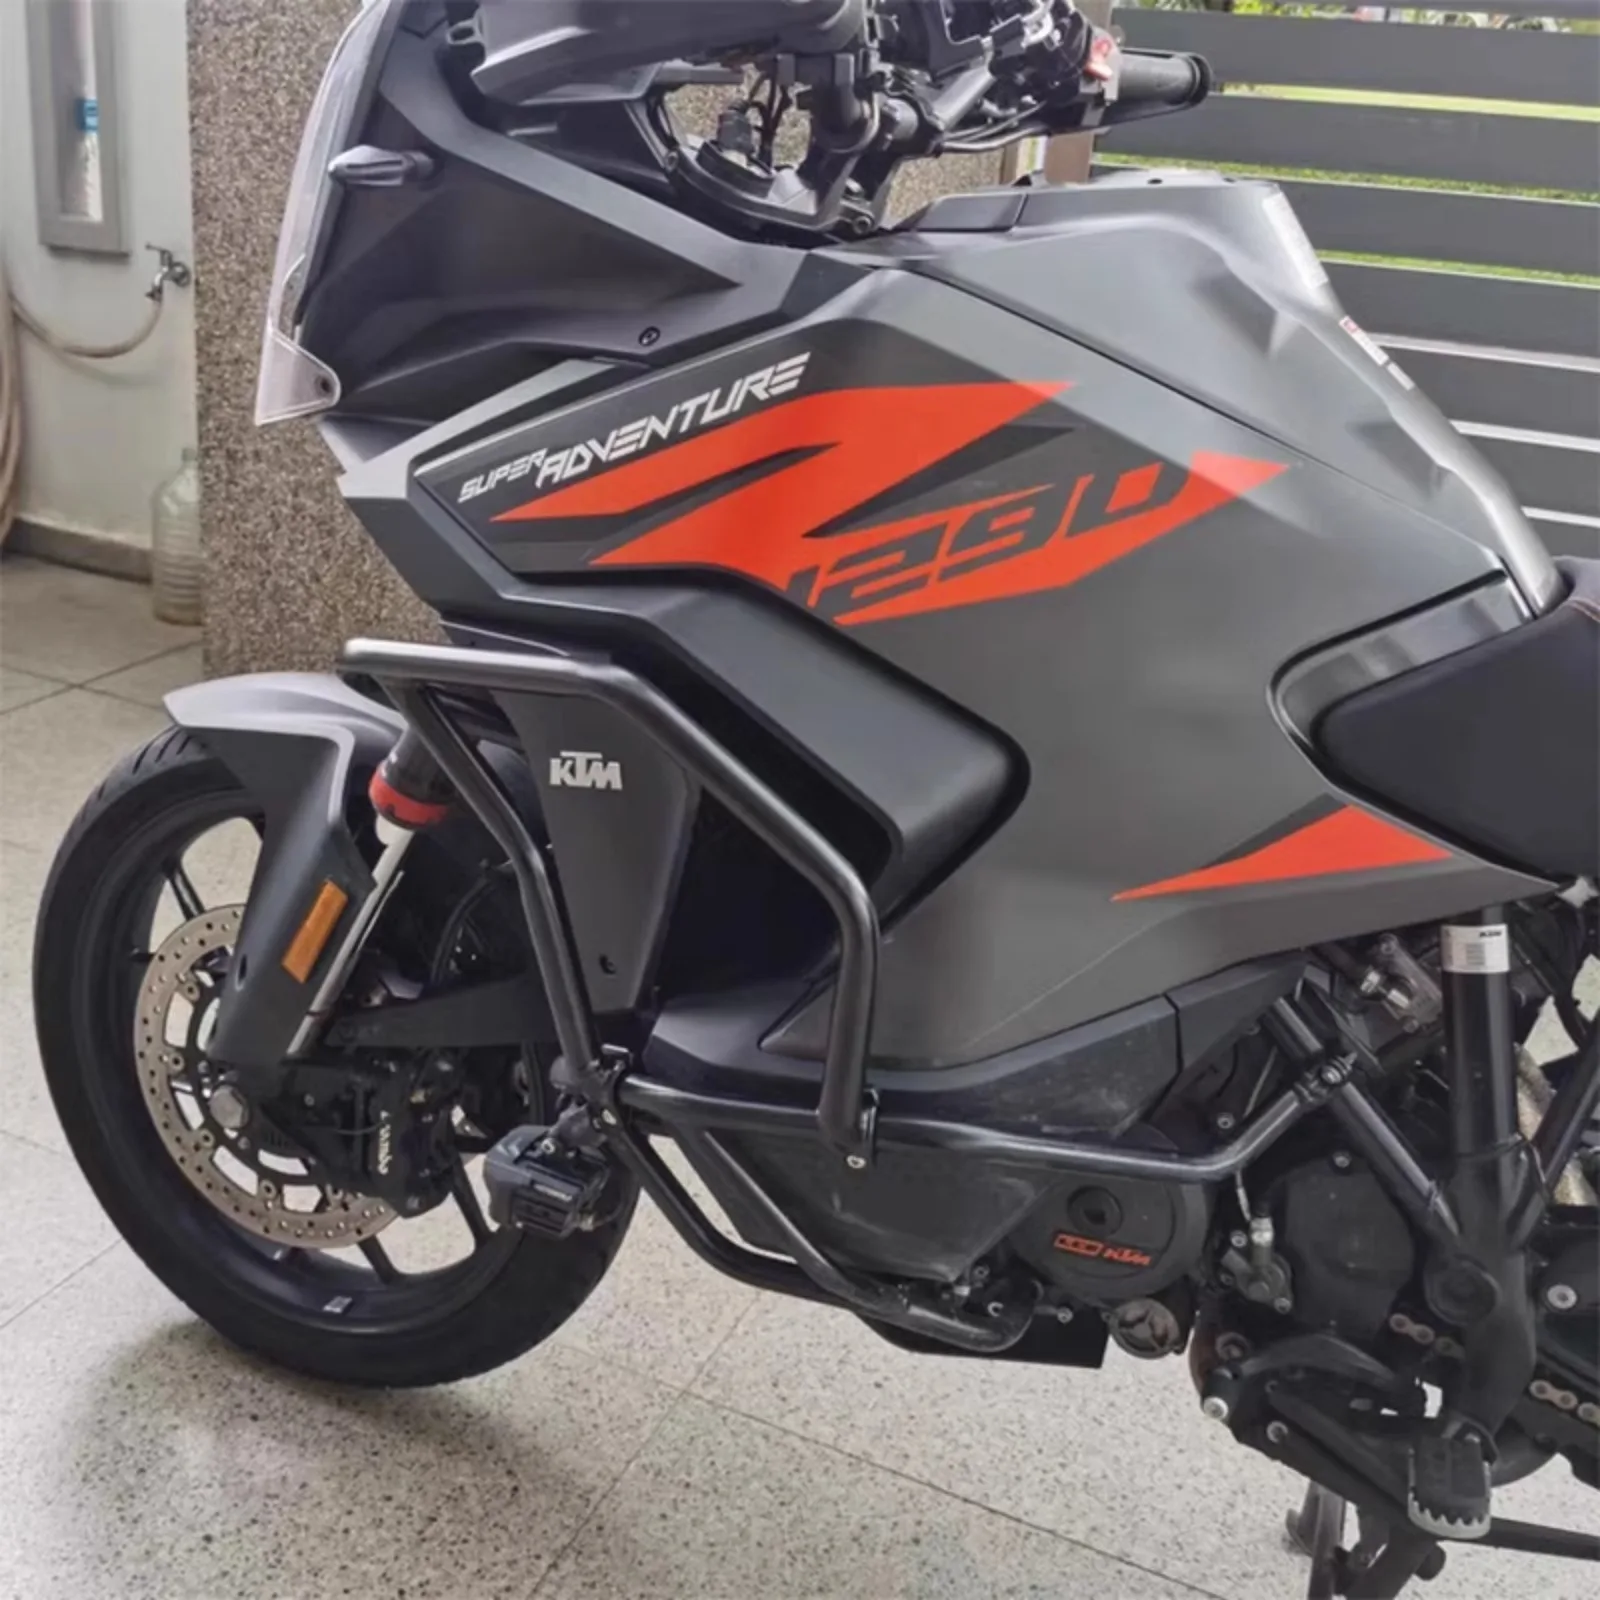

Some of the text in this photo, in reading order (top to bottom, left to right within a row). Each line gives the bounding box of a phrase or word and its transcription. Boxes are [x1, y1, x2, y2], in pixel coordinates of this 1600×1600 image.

[457, 352, 811, 503] SUPER ADVENTURE
[784, 458, 1192, 622] 1290
[549, 751, 622, 790] KTM
